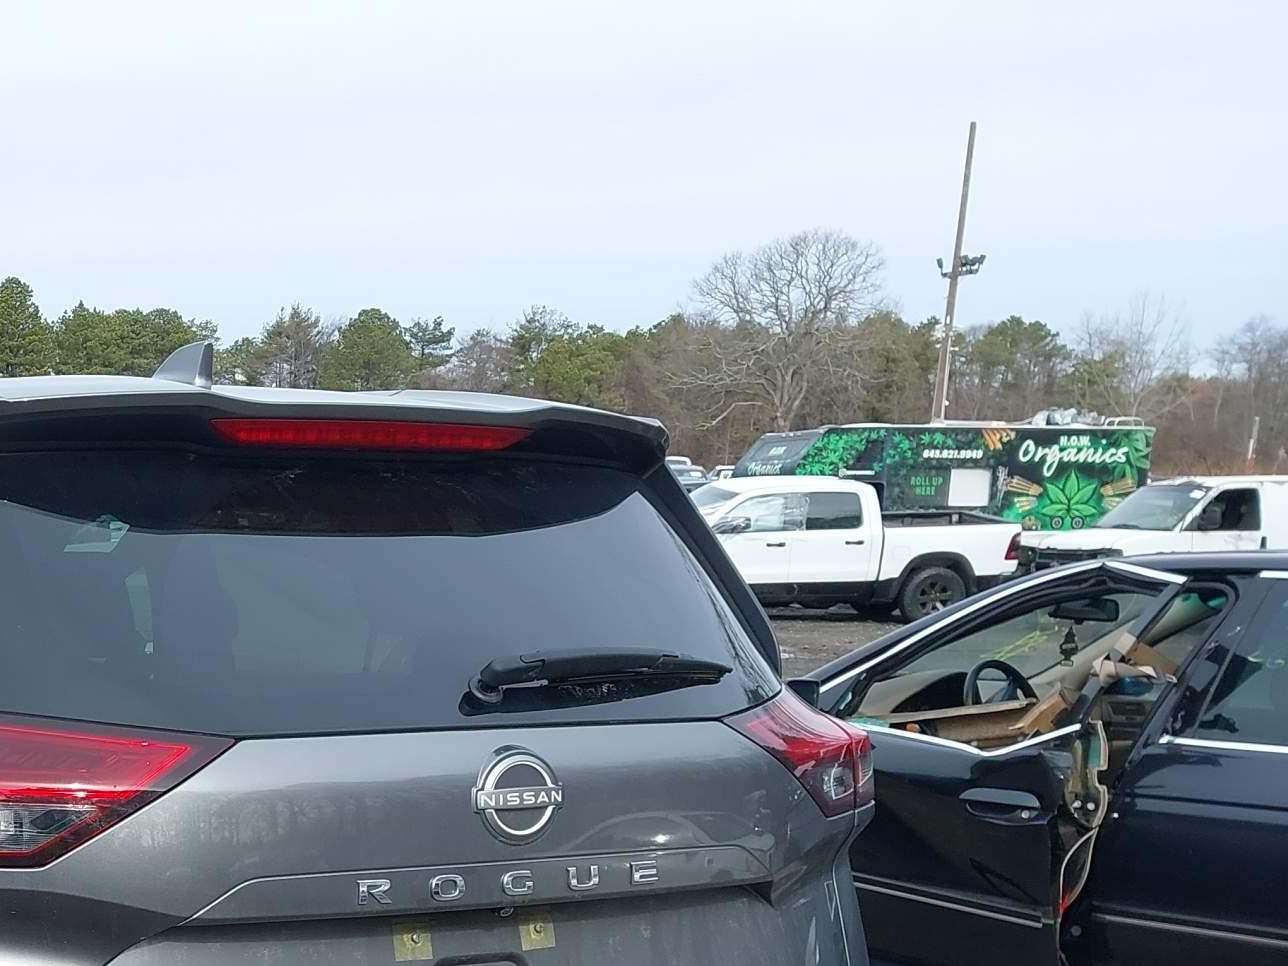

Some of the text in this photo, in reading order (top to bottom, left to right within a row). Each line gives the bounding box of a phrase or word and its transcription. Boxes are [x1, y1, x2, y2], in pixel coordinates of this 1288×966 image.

[1019, 439, 1129, 477] Organics
[910, 476, 944, 486] ROLL UP
[479, 789, 563, 808] NISSAN
[356, 859, 660, 905] ROGUE
